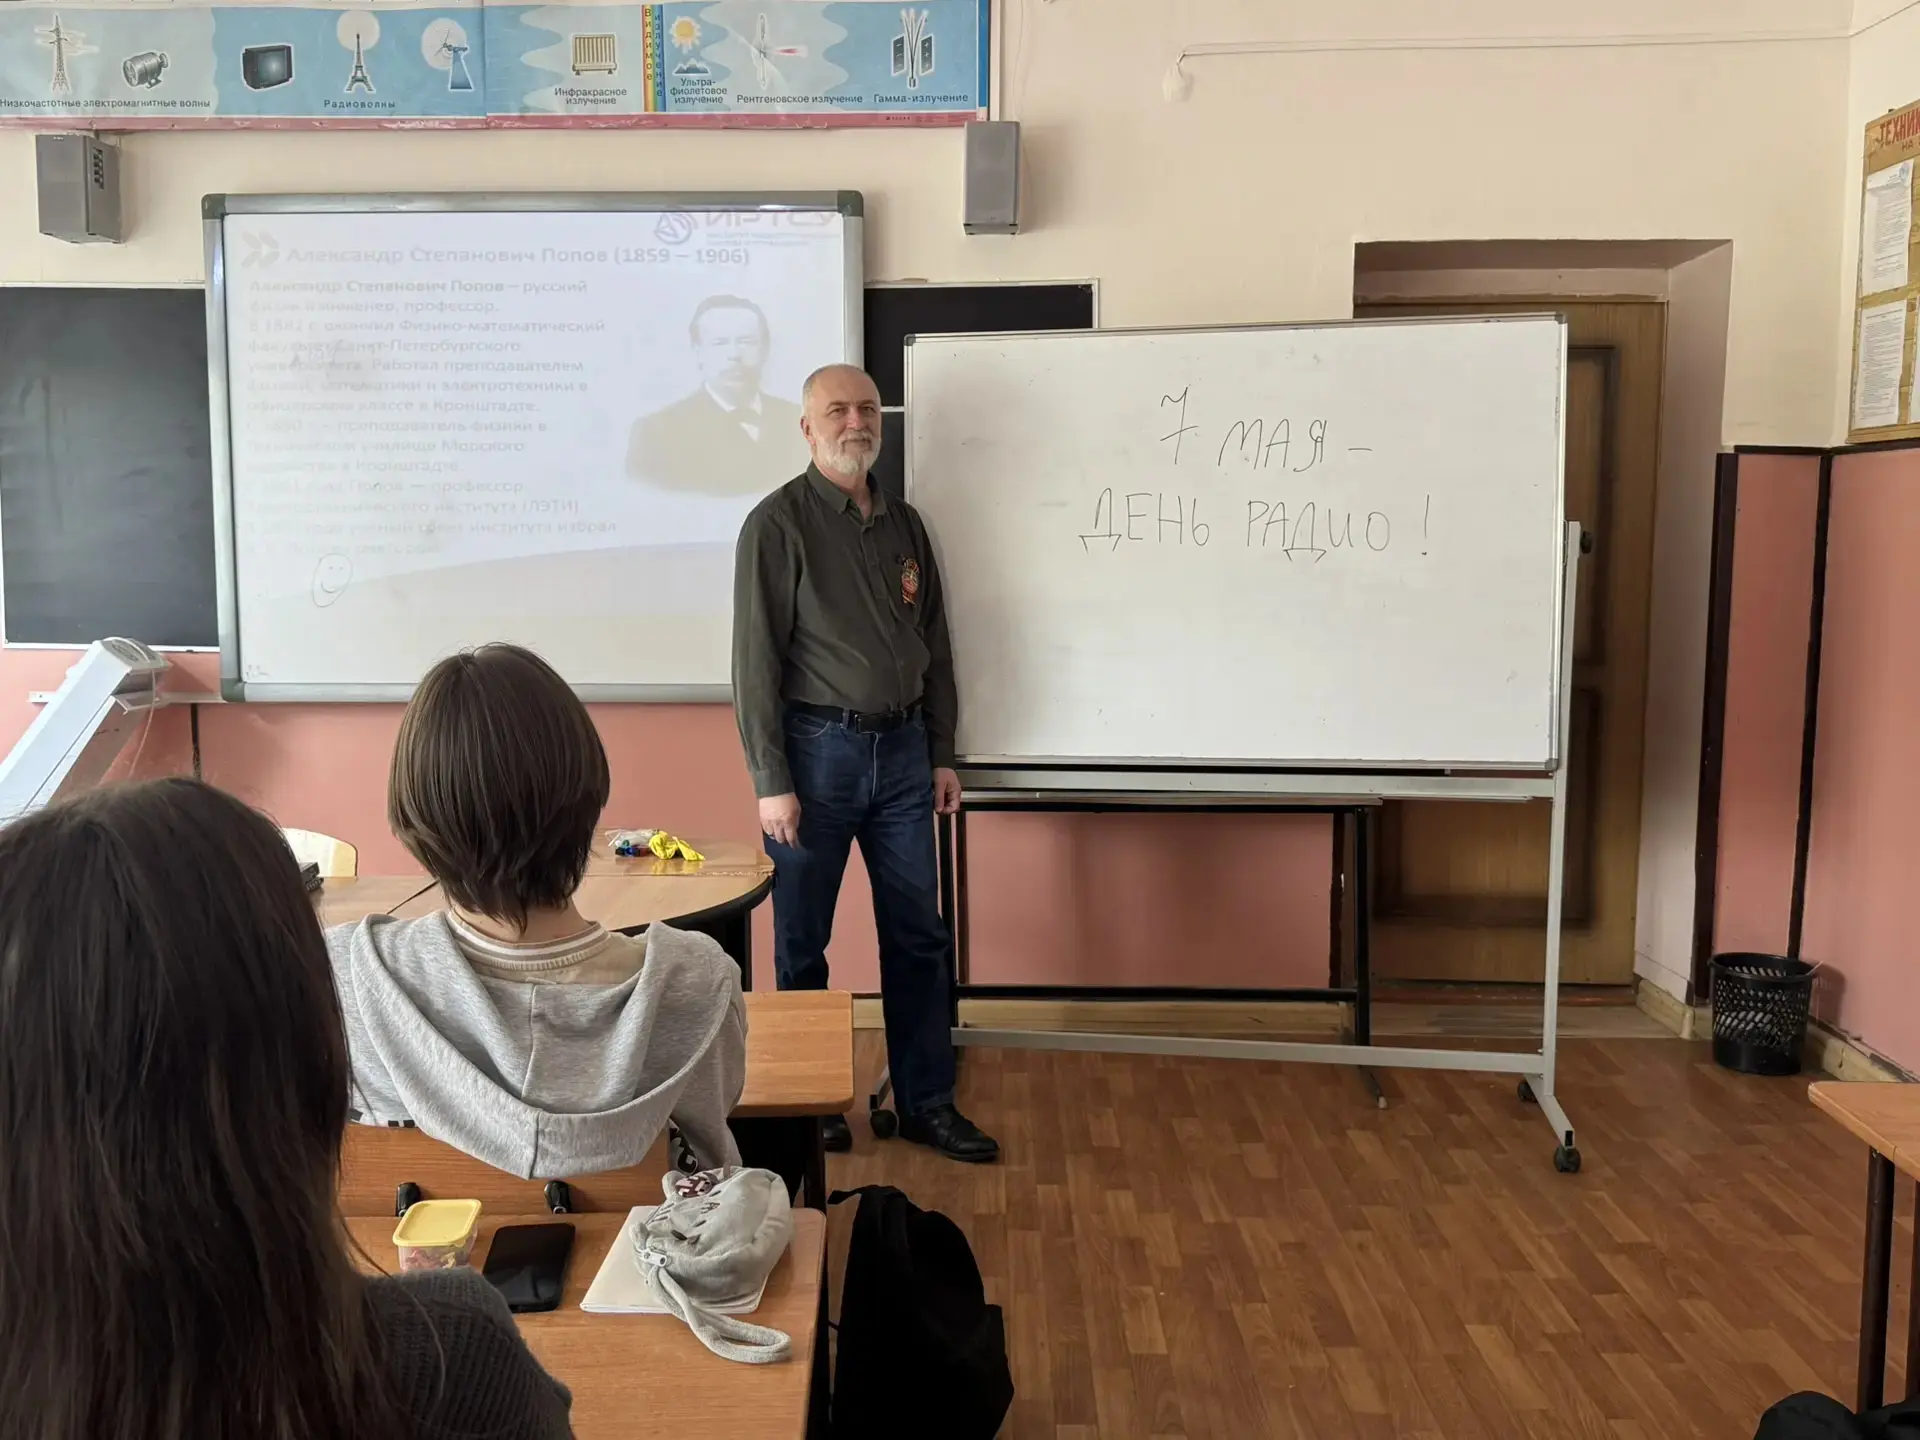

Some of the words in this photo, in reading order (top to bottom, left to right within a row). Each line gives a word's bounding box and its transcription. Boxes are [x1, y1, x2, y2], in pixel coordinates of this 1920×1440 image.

[680, 78, 716, 87] Ультра-
[554, 88, 628, 97] Инфракрасное
[670, 87, 728, 97] фиолетовое
[873, 93, 969, 104] Гамма-излучение
[83, 99, 177, 109] электромагнитные
[179, 99, 211, 108] волны
[324, 99, 396, 109] Радиоволны
[566, 97, 617, 105] излучение
[674, 96, 724, 105] излучение
[736, 94, 810, 104] Рентгеновское
[811, 95, 863, 104] излучение
[287, 248, 404, 265] Александр
[409, 247, 535, 263] Степанович
[541, 248, 608, 263] Попов
[614, 246, 671, 266] (1859
[695, 246, 750, 267] 1906)
[346, 281, 446, 293] Степанович
[451, 280, 505, 293] Попов
[523, 280, 588, 295] русский
[404, 301, 500, 314] профессор.
[398, 319, 606, 333] Физико-математический
[444, 361, 585, 374] преподавателем
[441, 381, 575, 393] электротехники
[433, 399, 542, 413] Кронштадте.
[1160, 386, 1199, 465] 7
[1218, 418, 1328, 473] МАЯ
[442, 439, 525, 453] Морского
[431, 479, 524, 496] профессор
[522, 498, 580, 516] (ЛЭТИ)
[1078, 487, 1210, 555] ДЕНЬ
